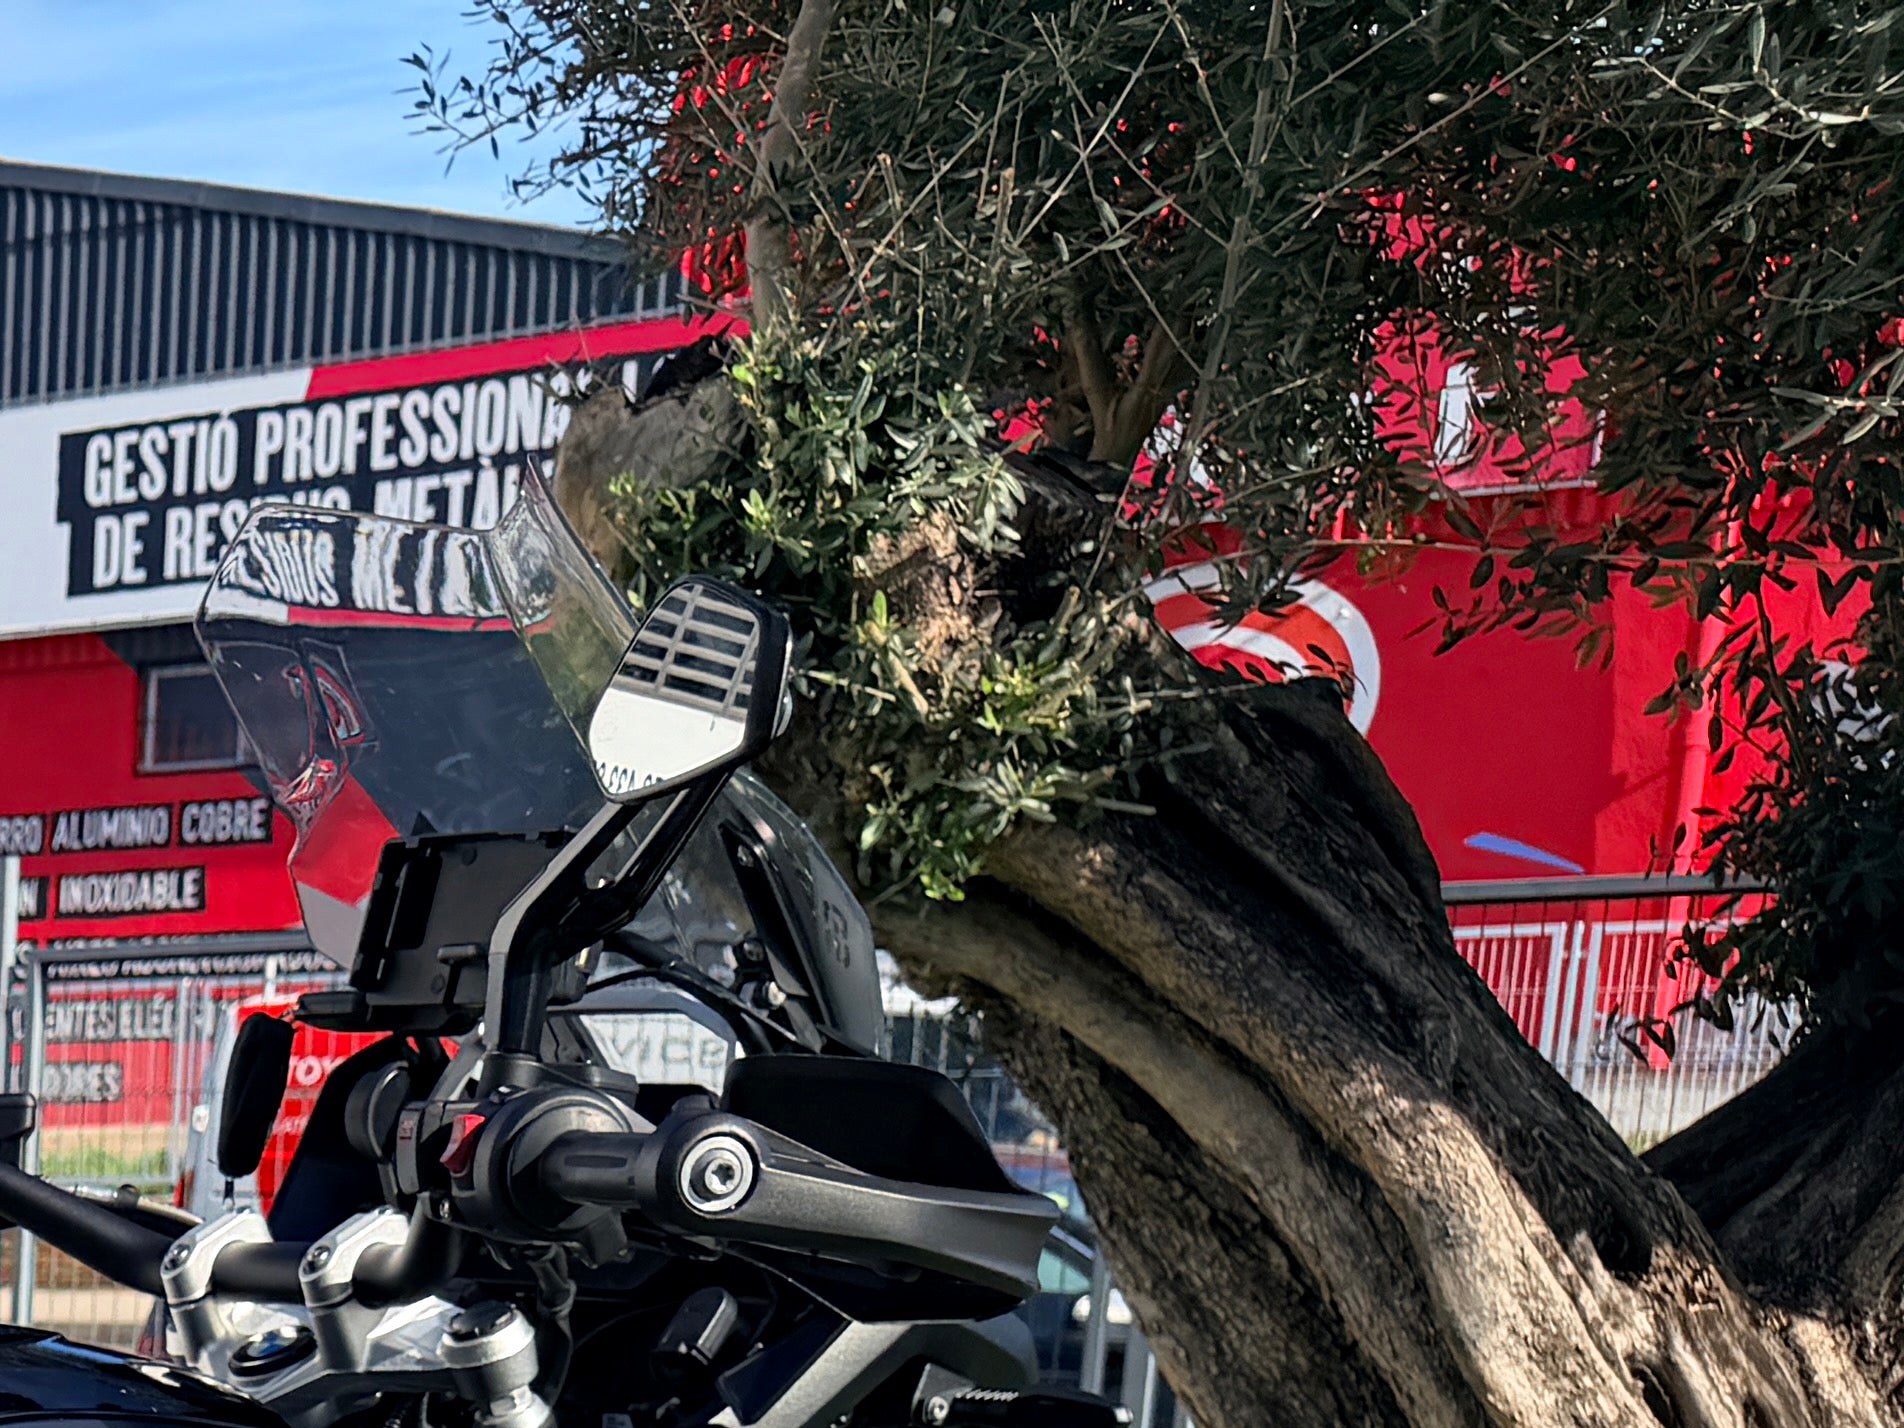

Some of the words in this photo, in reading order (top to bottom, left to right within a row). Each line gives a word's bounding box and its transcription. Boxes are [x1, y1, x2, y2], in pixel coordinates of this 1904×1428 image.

[84, 412, 239, 508] GESTIÓ
[253, 364, 593, 486] PROFESSIONA
[94, 510, 147, 589] DE
[51, 806, 171, 852] ALUMINIO
[181, 798, 270, 843] COBRE
[58, 868, 201, 915] INOXIDABLE
